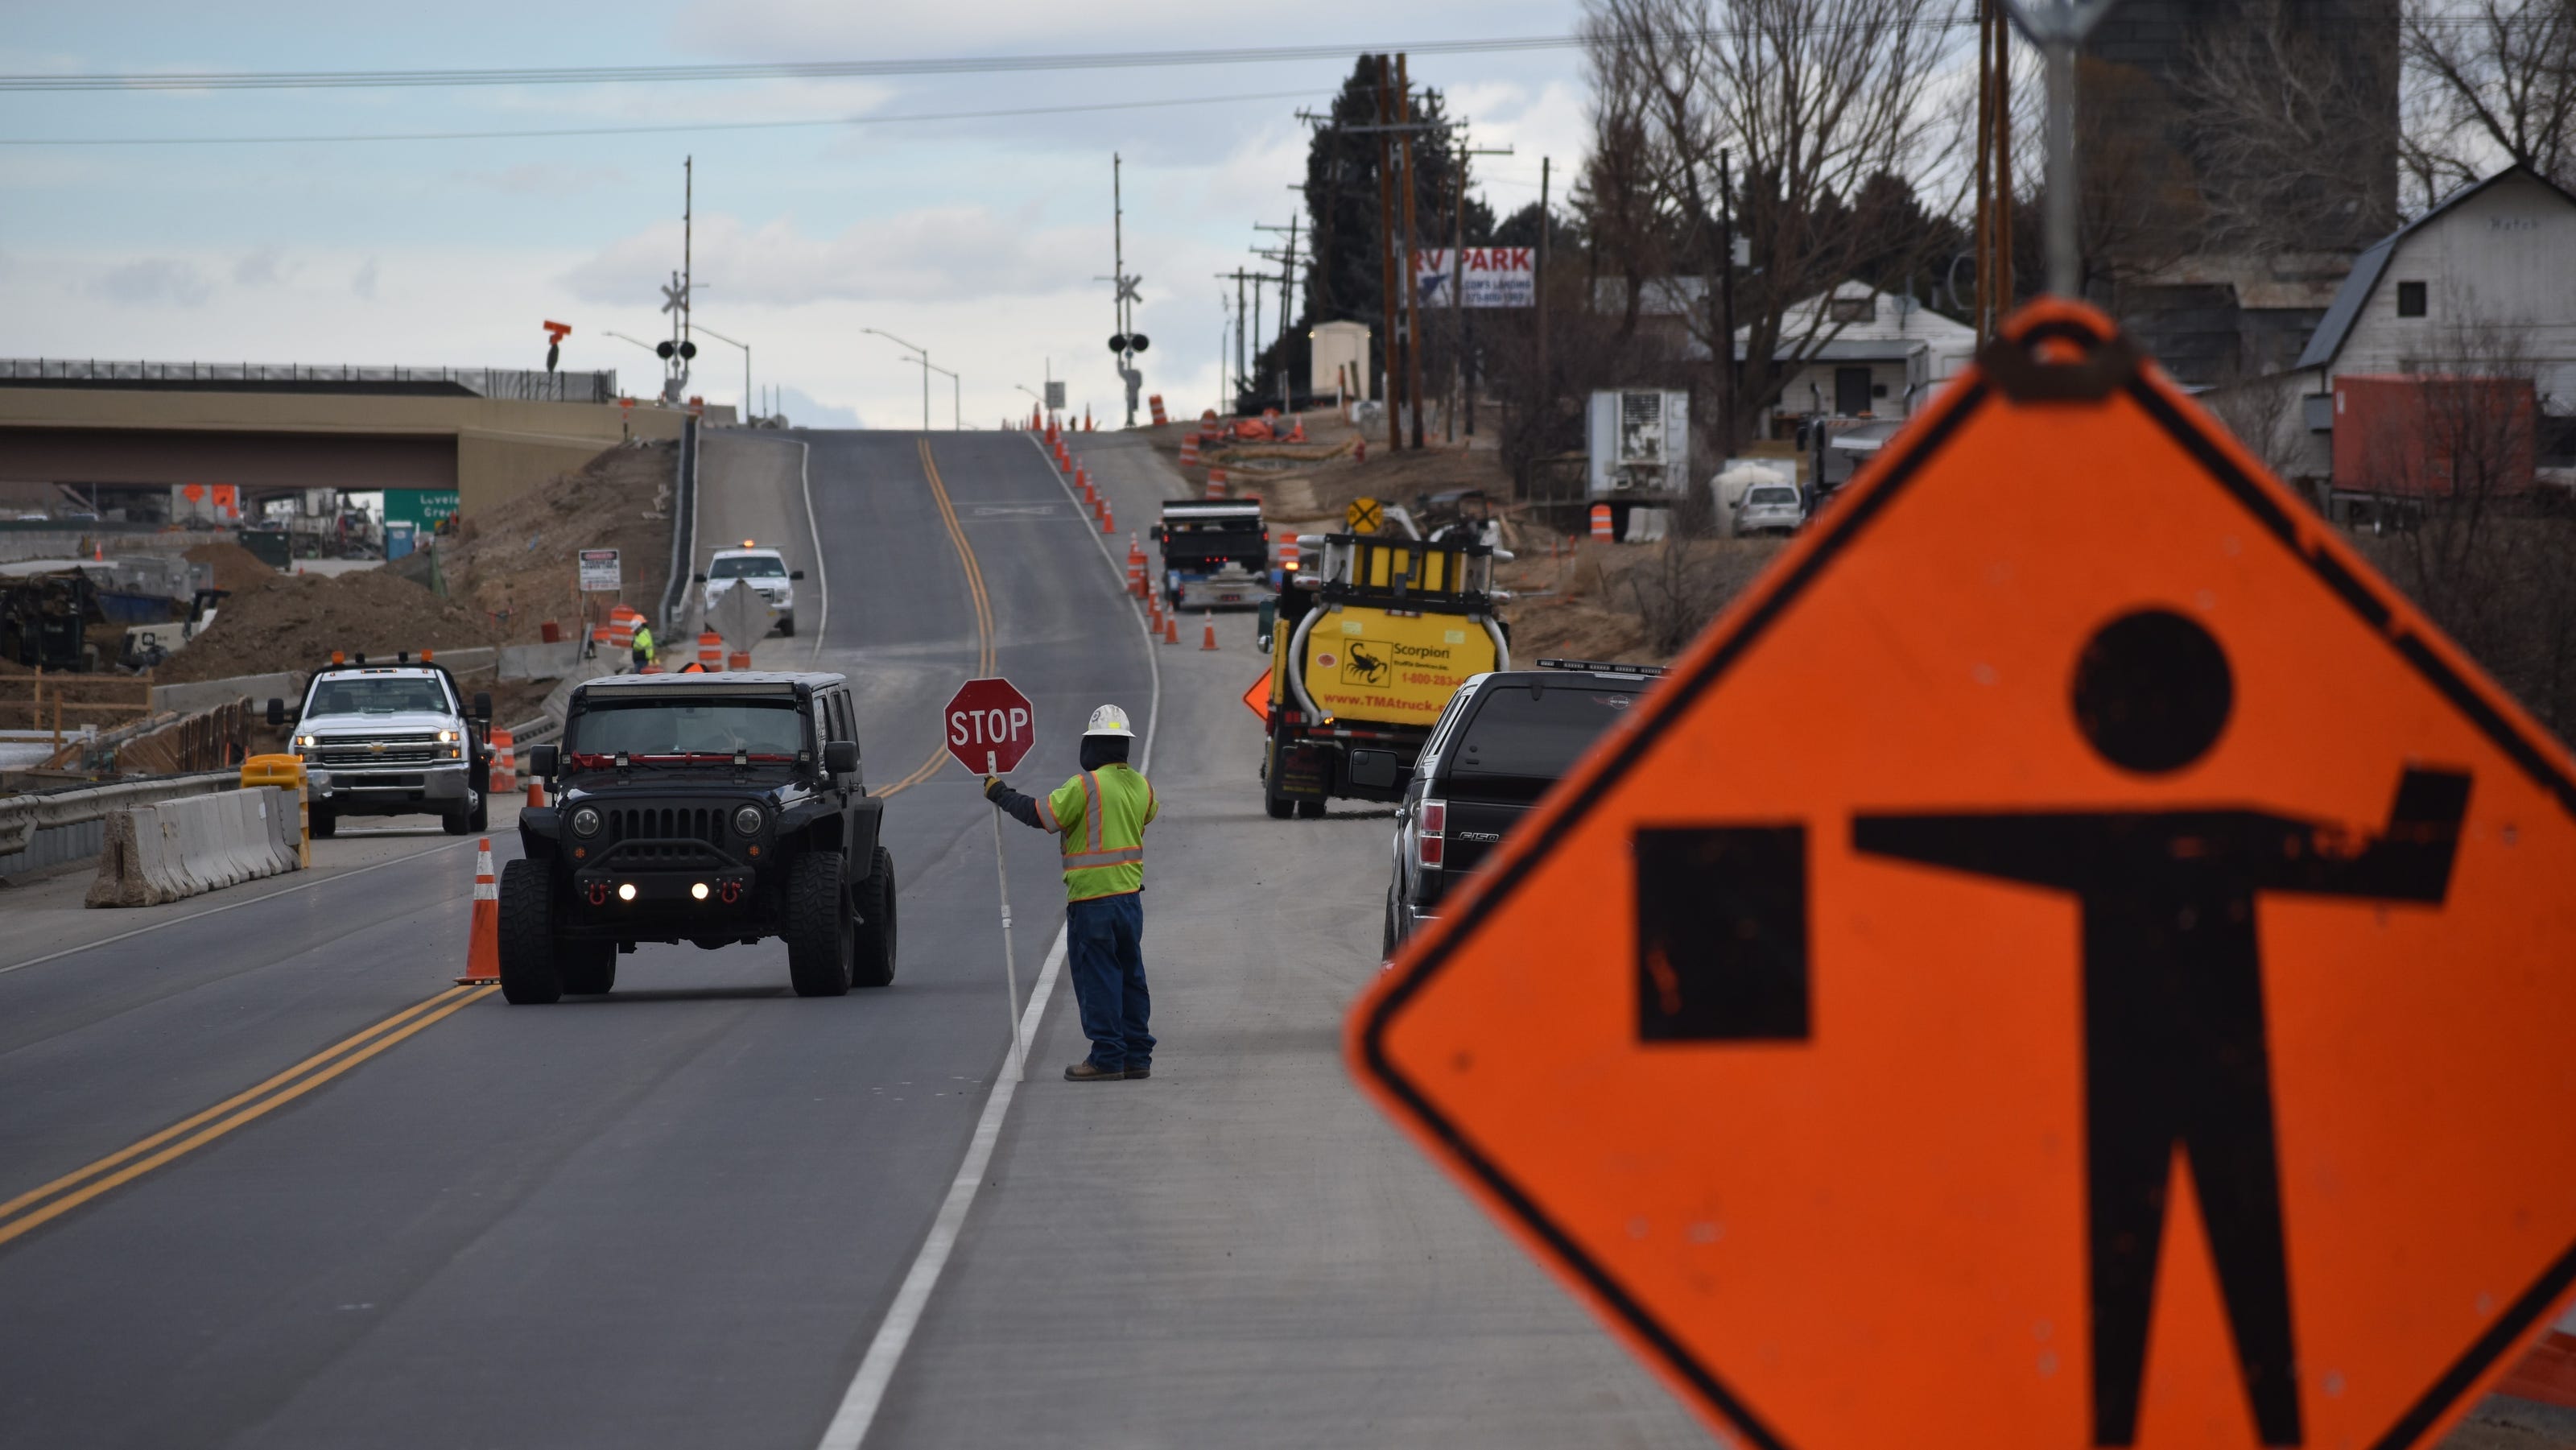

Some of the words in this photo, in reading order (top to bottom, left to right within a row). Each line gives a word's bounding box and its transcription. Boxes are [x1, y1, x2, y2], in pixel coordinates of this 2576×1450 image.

[1462, 247, 1530, 271] PARK
[1393, 643, 1450, 659] Scorpion
[951, 708, 1028, 746] STOP
[1458, 832, 1500, 843] F-150
